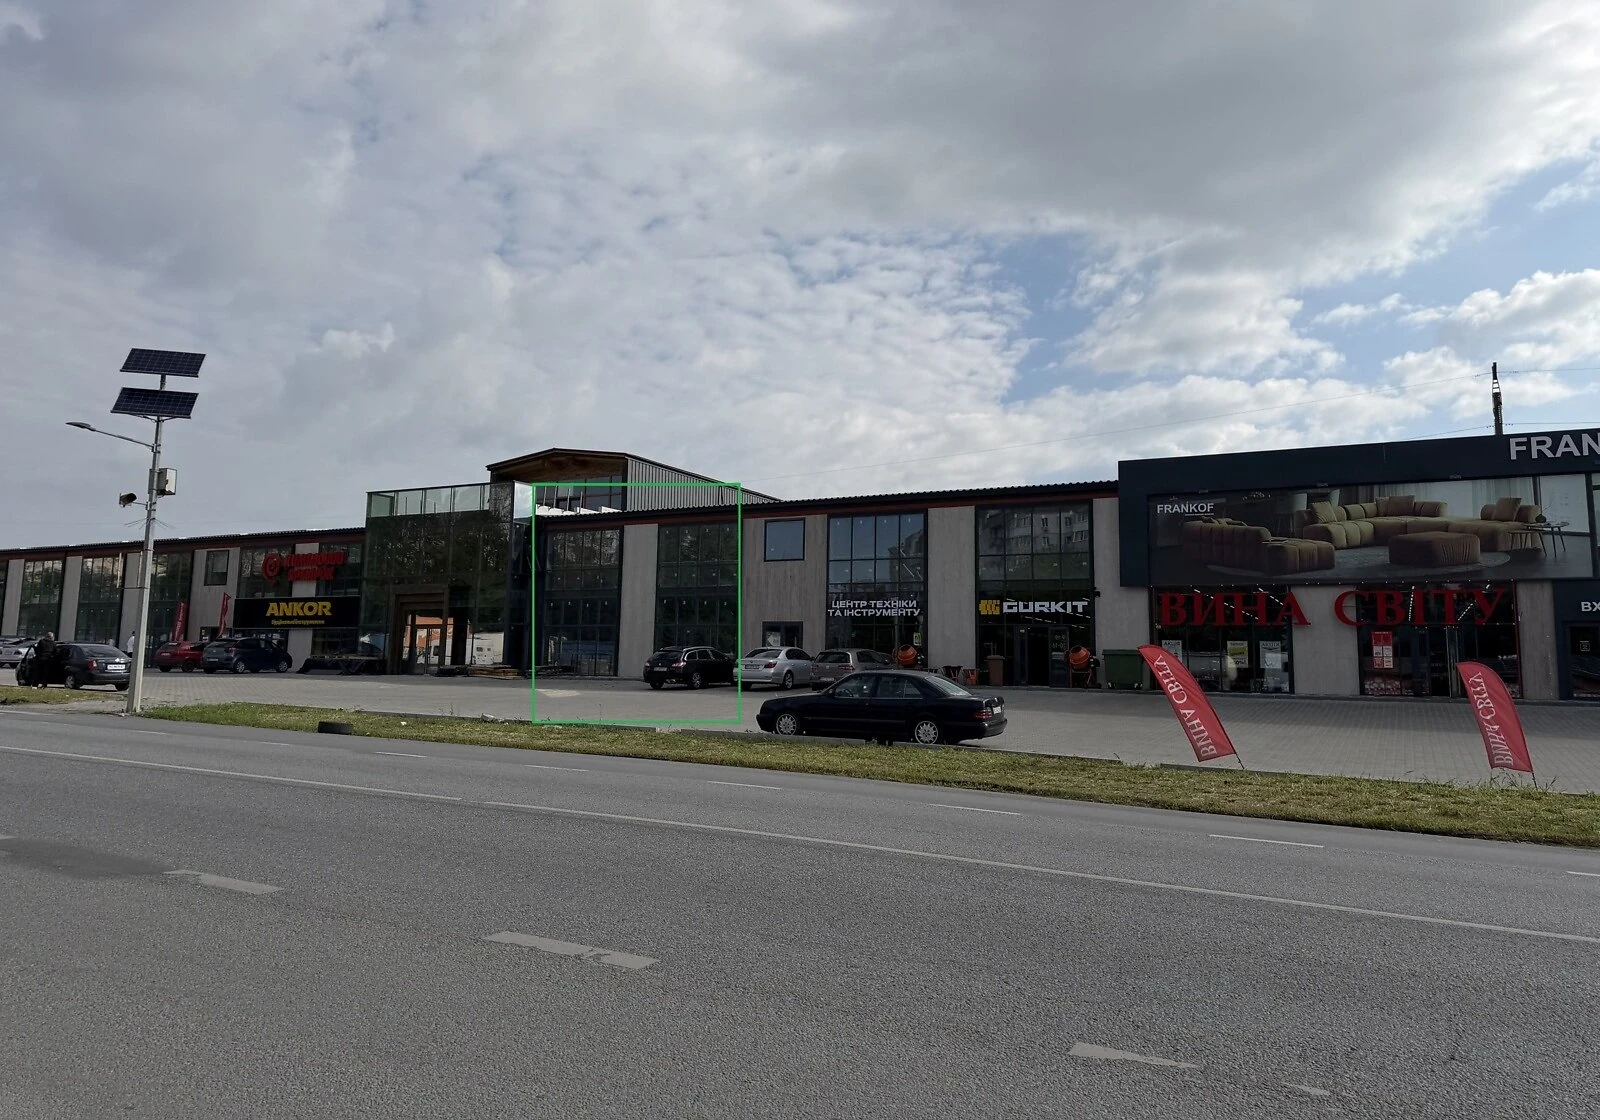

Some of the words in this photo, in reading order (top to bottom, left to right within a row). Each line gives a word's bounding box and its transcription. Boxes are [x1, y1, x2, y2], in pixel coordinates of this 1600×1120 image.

[1510, 432, 1600, 460] FRAN
[1157, 502, 1214, 513] FRANKOF
[266, 601, 332, 616] ANKOR
[832, 600, 867, 608] ЦЕНТР
[869, 600, 917, 608] ТЕХНІКИ
[1002, 601, 1089, 613] GURKIT
[1158, 592, 1311, 626] ВИНА
[1334, 589, 1505, 626] СВІТУ
